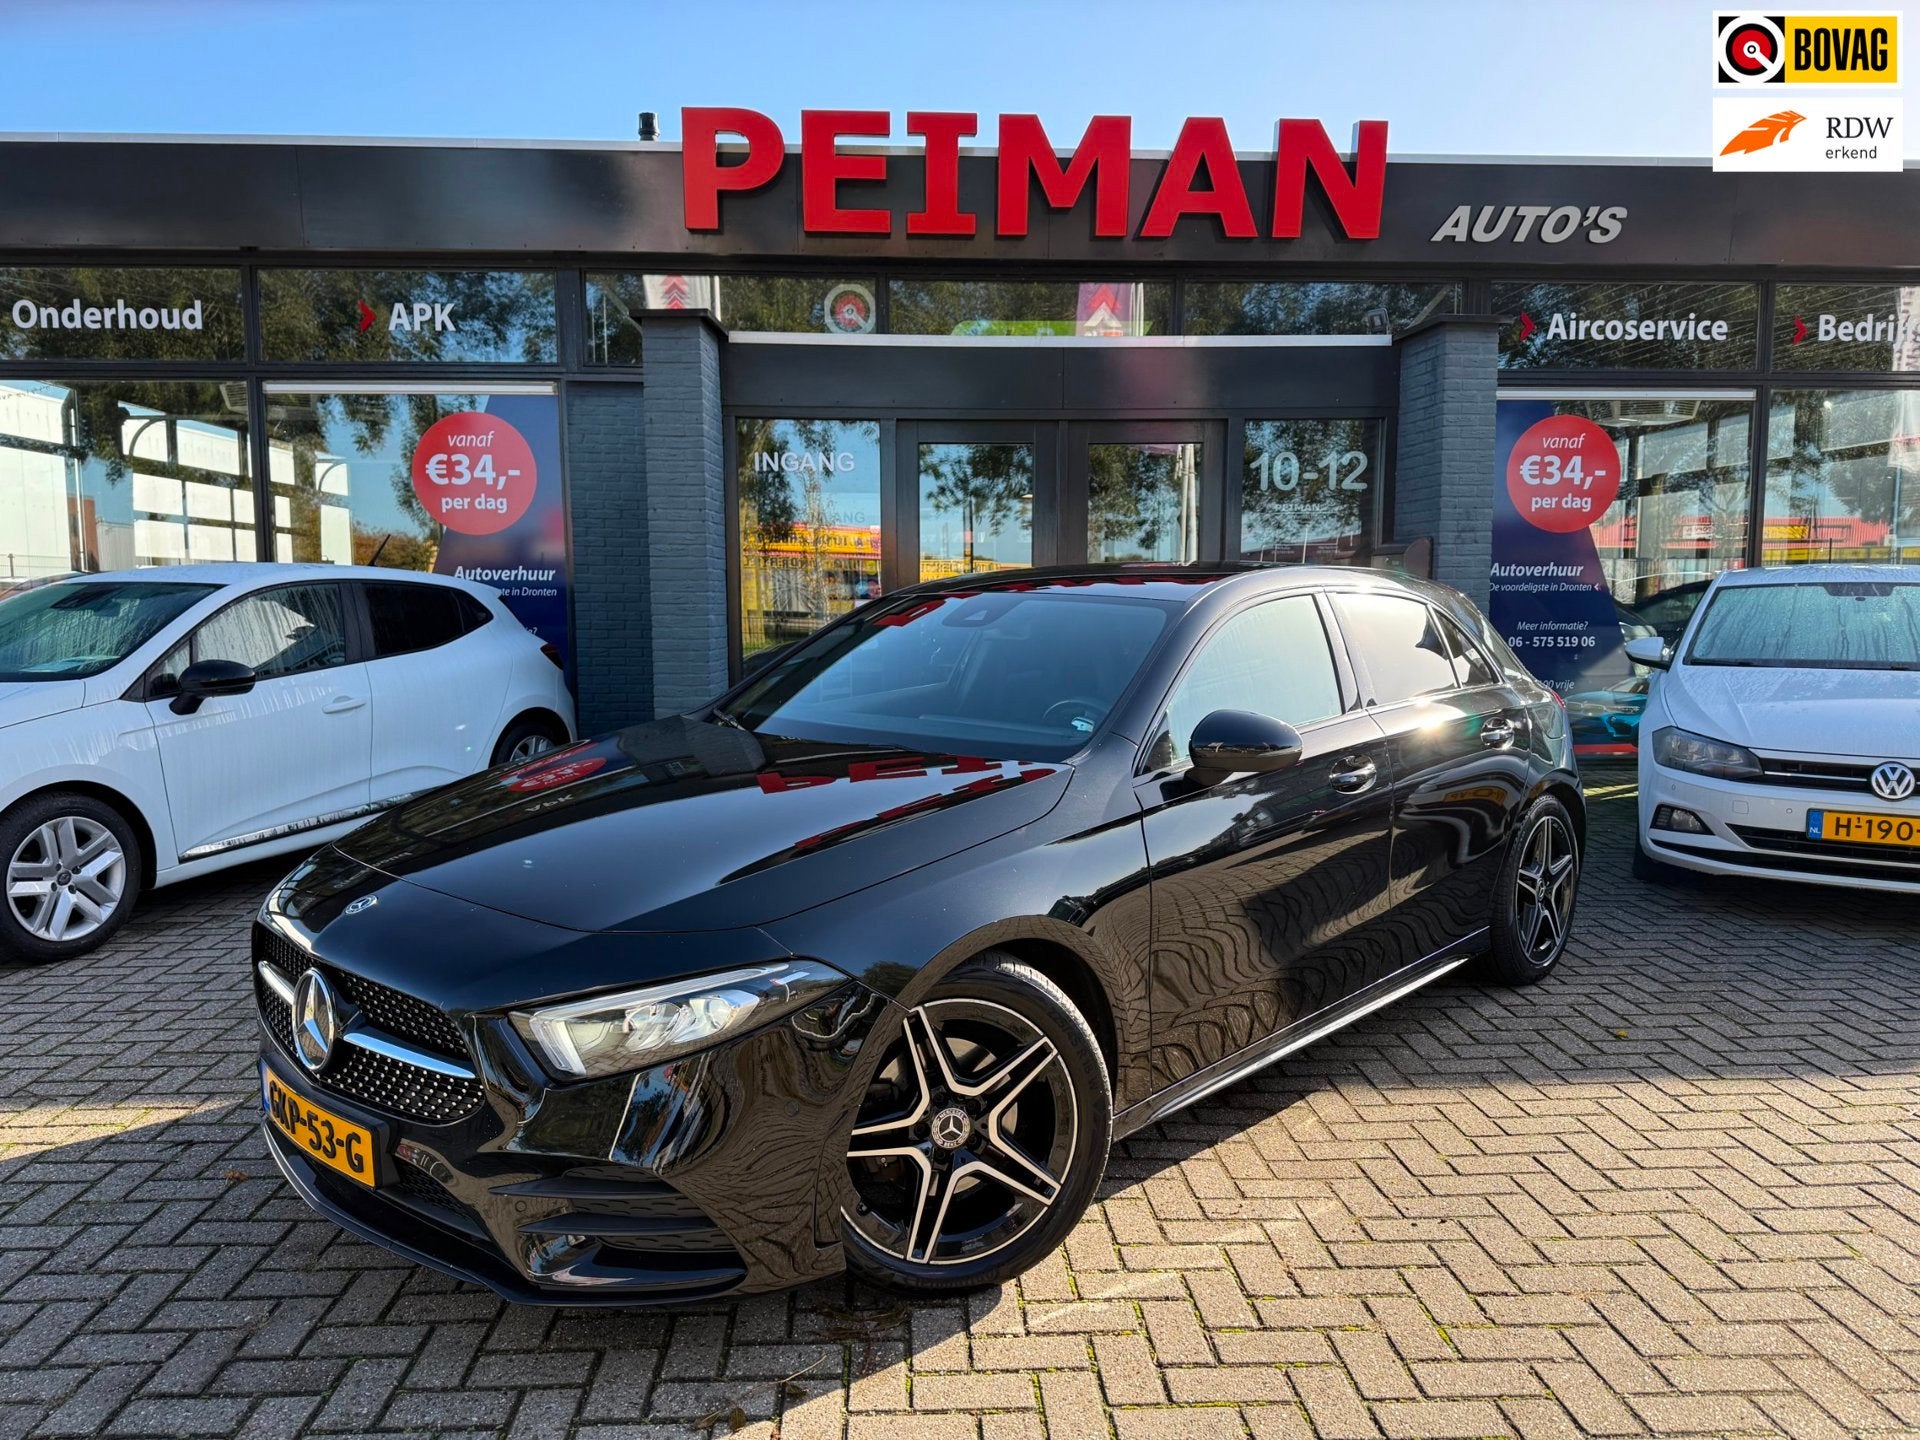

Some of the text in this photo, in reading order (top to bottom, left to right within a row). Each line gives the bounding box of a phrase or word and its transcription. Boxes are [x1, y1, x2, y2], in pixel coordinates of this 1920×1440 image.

[682, 107, 1389, 239] PEIMAN
[1430, 205, 1628, 243] AUTO'S
[12, 299, 203, 330] Onderhoud
[389, 303, 456, 332] APK
[1546, 312, 1728, 341] Aircoservice
[448, 431, 495, 447] vanaf
[1542, 433, 1586, 448] vanaf
[425, 453, 521, 490] €34,-
[754, 452, 855, 472] INGANG
[1250, 451, 1368, 491] 10-12
[1520, 455, 1606, 490] €34,-
[441, 494, 508, 513] per dag
[1531, 493, 1592, 512] per dag
[454, 565, 556, 581] Autoverhuur
[1489, 562, 1584, 577] Autoverhuur
[511, 586, 521, 596] in
[521, 586, 557, 596] Dronten
[1489, 582, 1592, 594] De voordeligste in Dronten
[1517, 621, 1588, 631] Meer informatie?
[1508, 636, 1523, 648] 06
[1532, 636, 1554, 648] 575
[1556, 636, 1578, 648] 519
[1581, 636, 1596, 648] 06
[1555, 680, 1575, 691] vrije
[1809, 826, 1821, 834] NL
[269, 1080, 364, 1173] GKP-53-G
